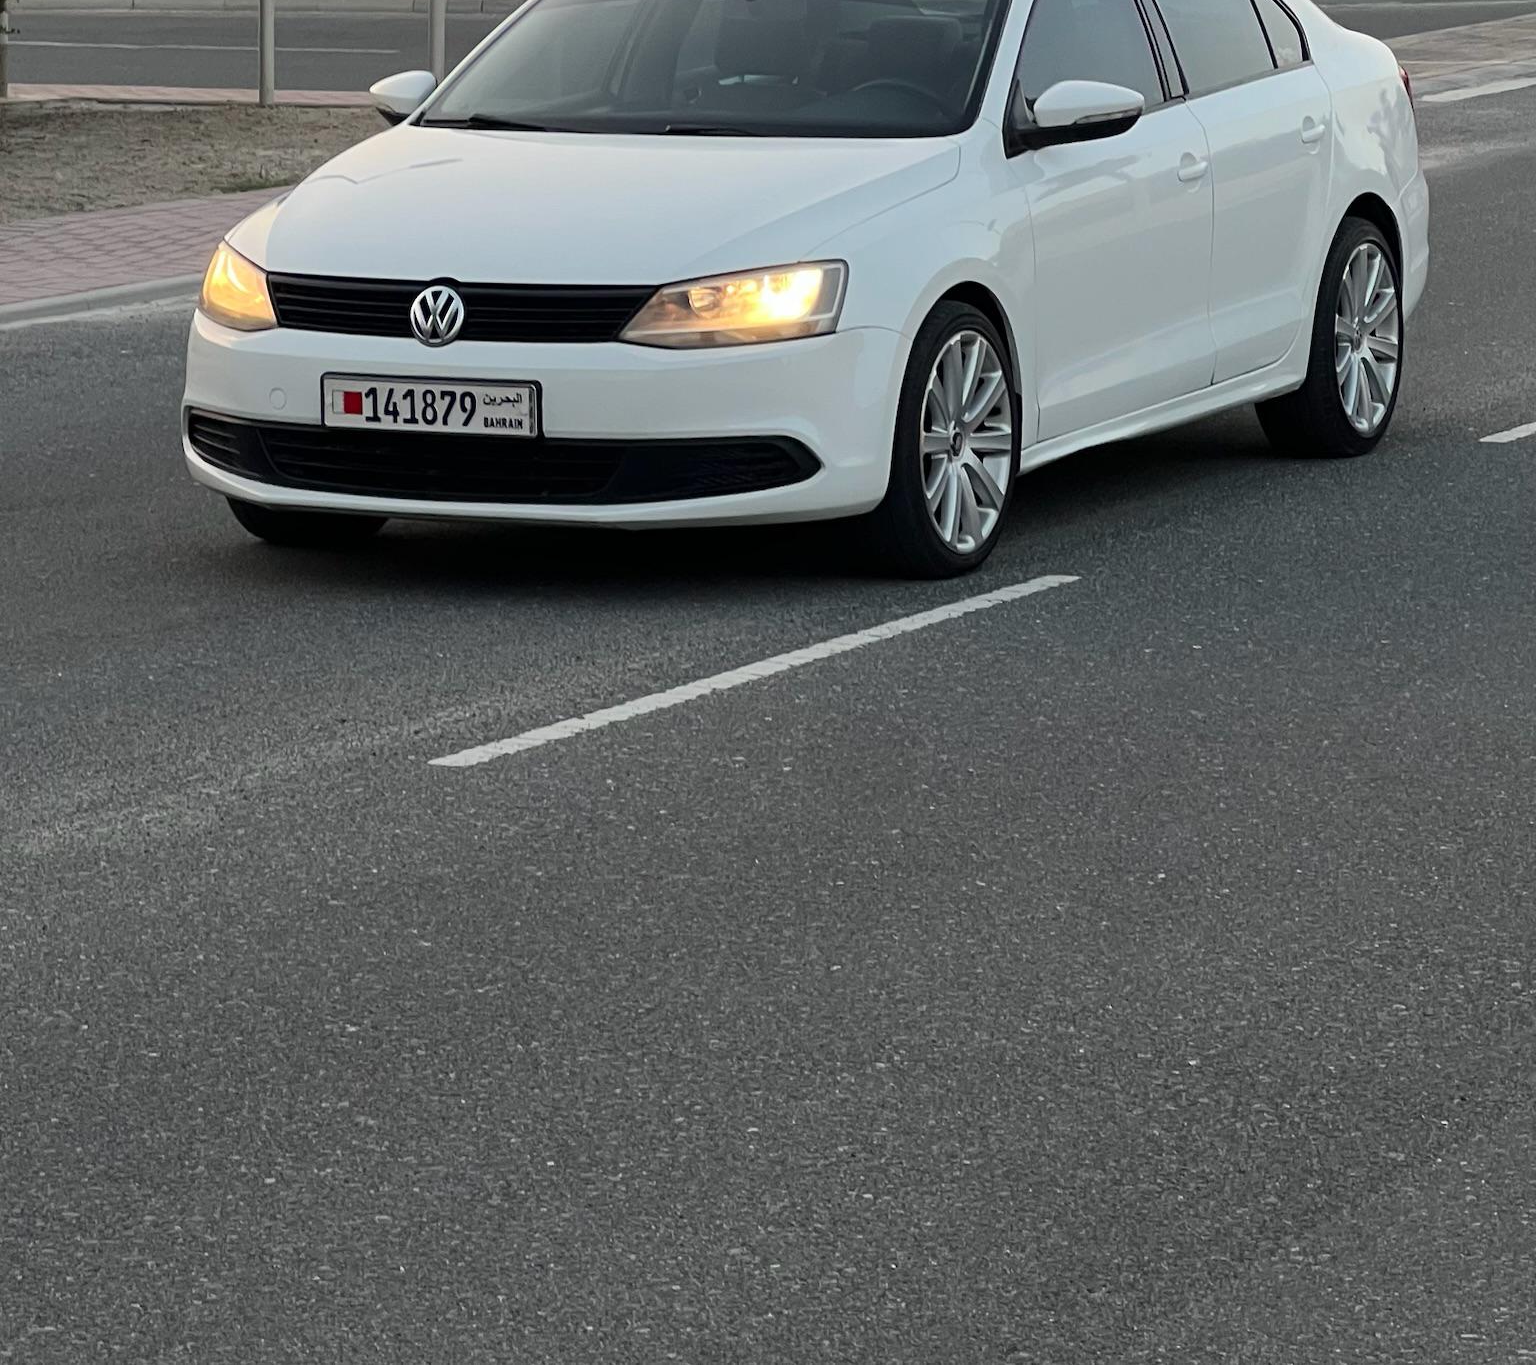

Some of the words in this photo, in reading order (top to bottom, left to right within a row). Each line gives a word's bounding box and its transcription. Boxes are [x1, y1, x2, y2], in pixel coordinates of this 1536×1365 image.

[410, 285, 464, 343] VW
[364, 387, 477, 427] 141879
[483, 392, 523, 408] البحرين
[483, 416, 523, 430] BAHRAIN
